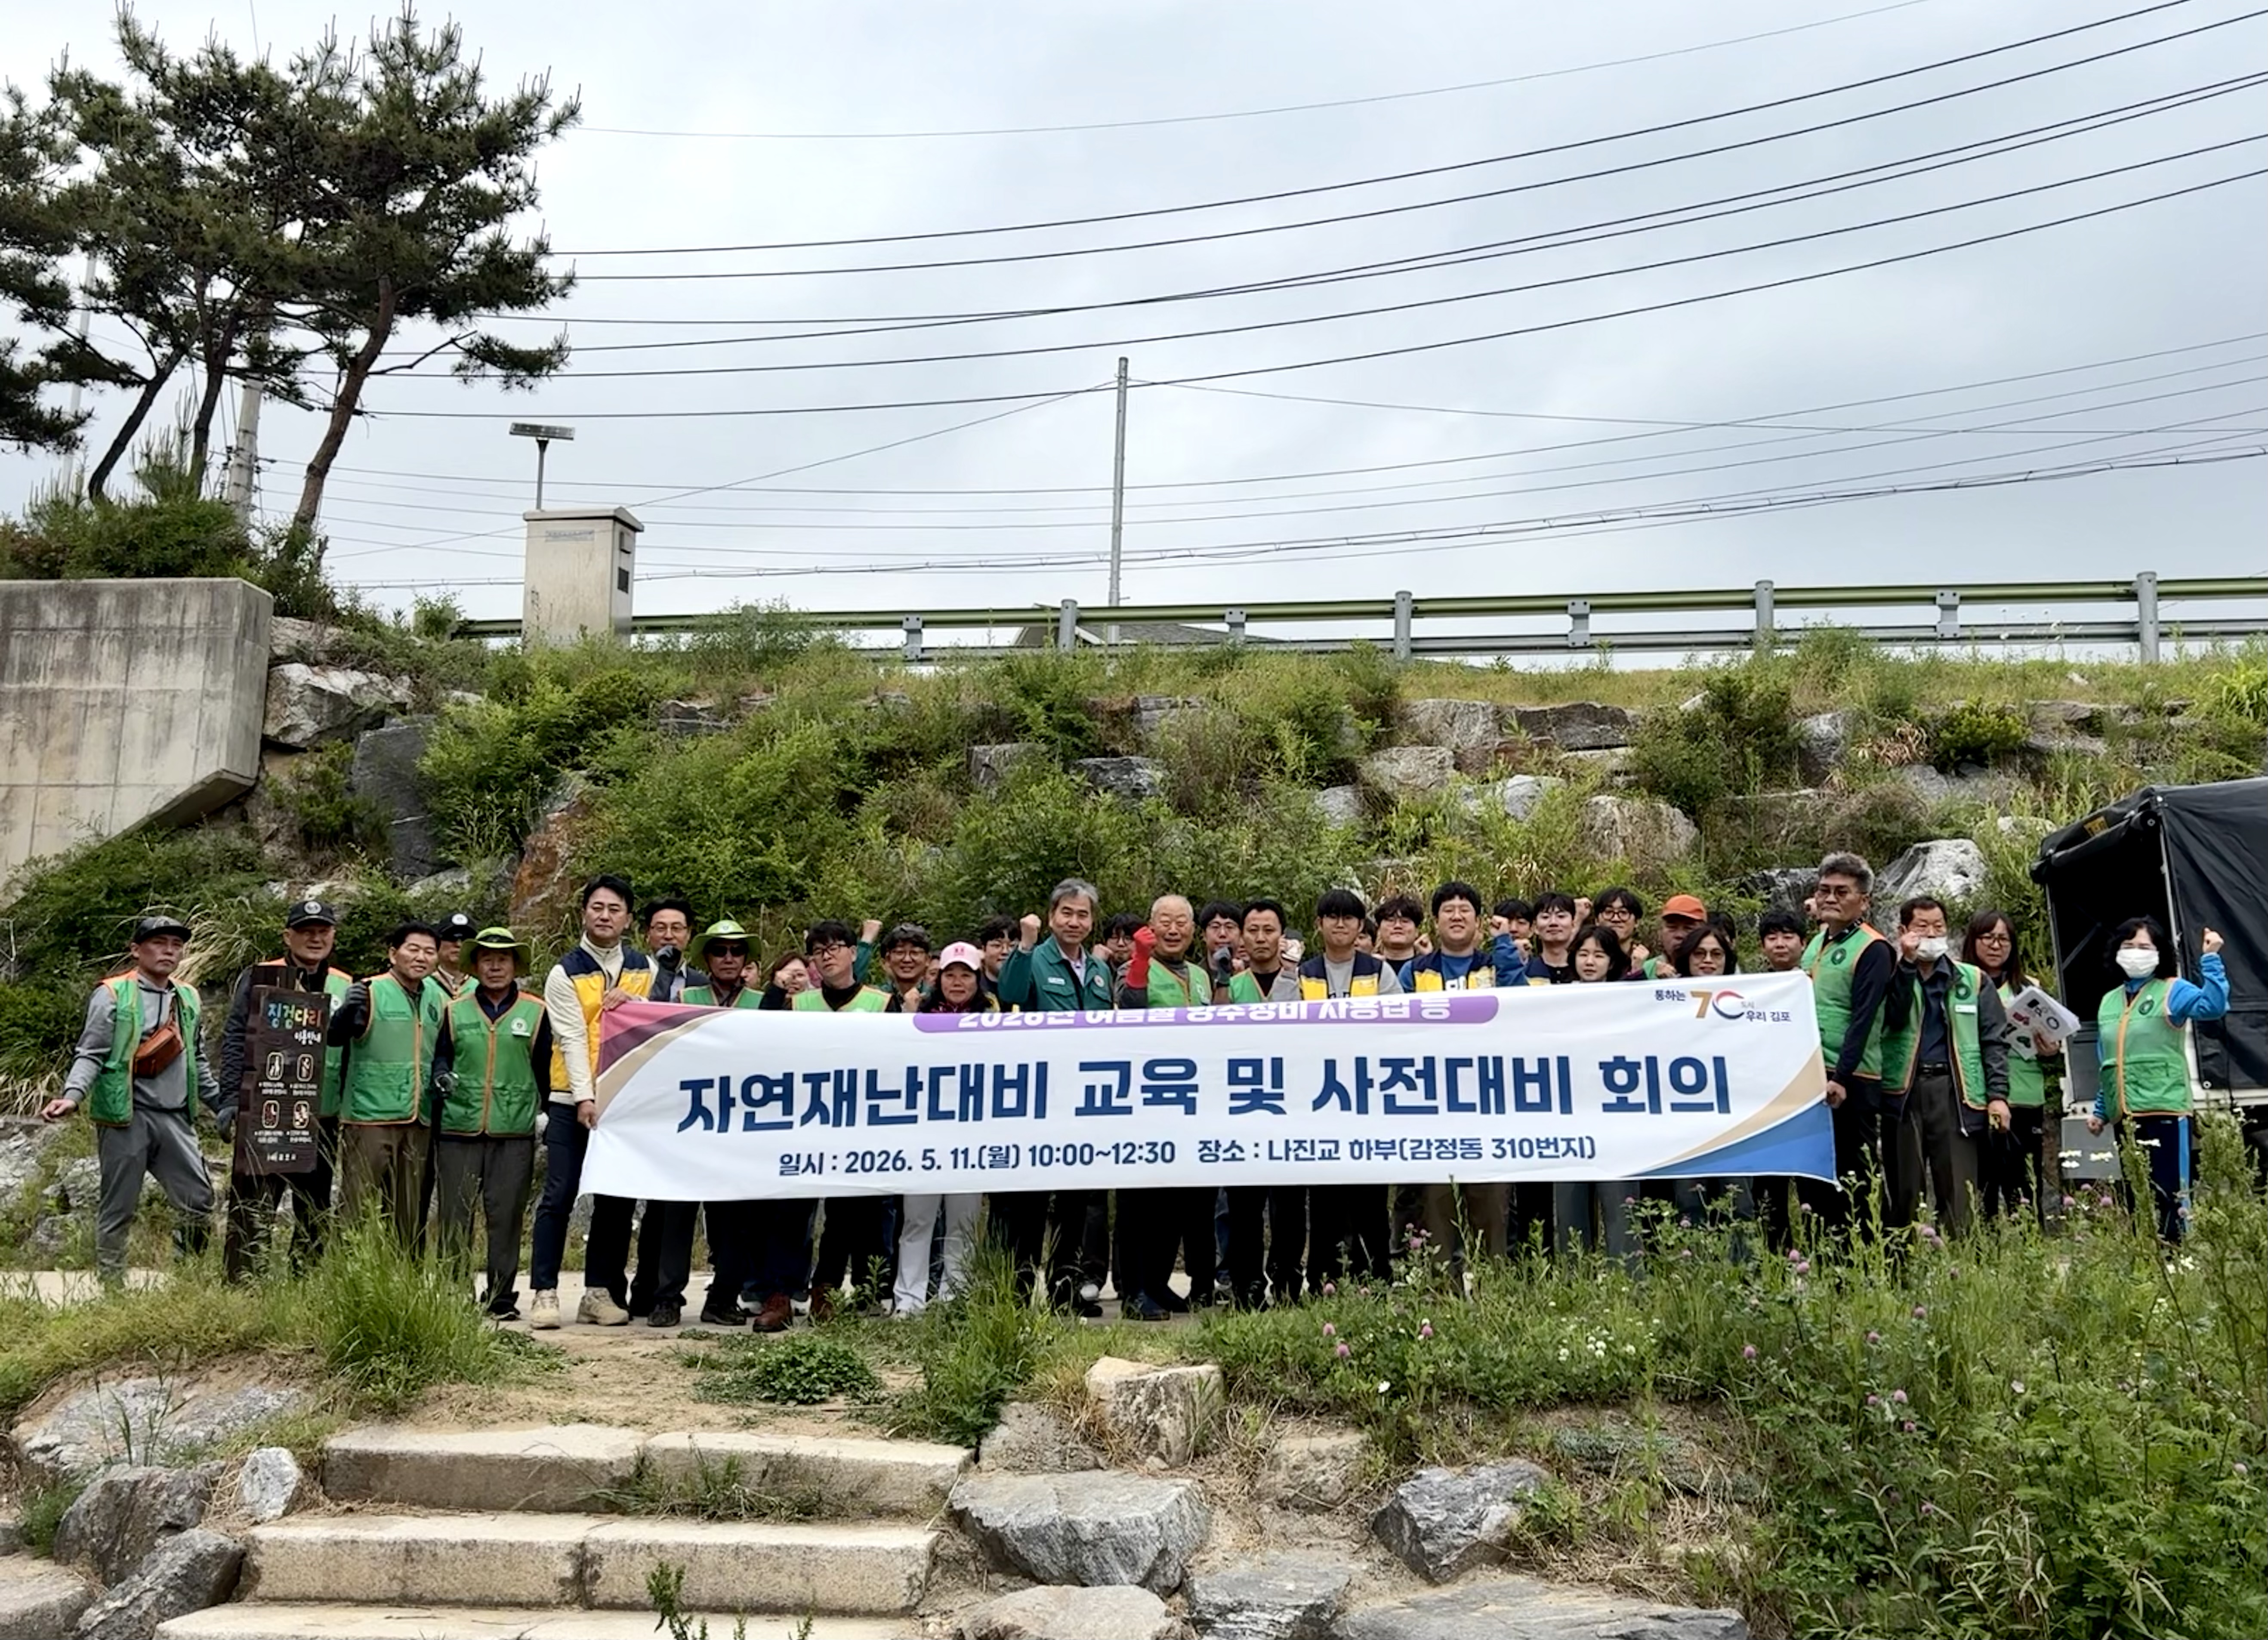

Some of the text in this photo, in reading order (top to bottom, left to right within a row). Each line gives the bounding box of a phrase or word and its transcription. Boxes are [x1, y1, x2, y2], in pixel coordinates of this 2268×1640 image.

[1655, 990, 1686, 1001] 통하는
[268, 1003, 322, 1029] 징검다리
[1746, 1011, 1792, 1022] 우리 김포
[677, 1055, 1731, 1133] 자연재난대비 교육 및 사전대비 회의
[779, 1152, 824, 1176] 일시
[844, 1149, 913, 1174] 2026.
[921, 1148, 942, 1171] 5.
[950, 1144, 1020, 1170] 11.(월)
[1028, 1141, 1176, 1167] 10:00~12:30
[1198, 1139, 1245, 1163] 장소
[1268, 1139, 1340, 1162] 나진교
[1349, 1138, 1483, 1161] 하부(감정동
[1491, 1135, 1596, 1160] 310번지)
